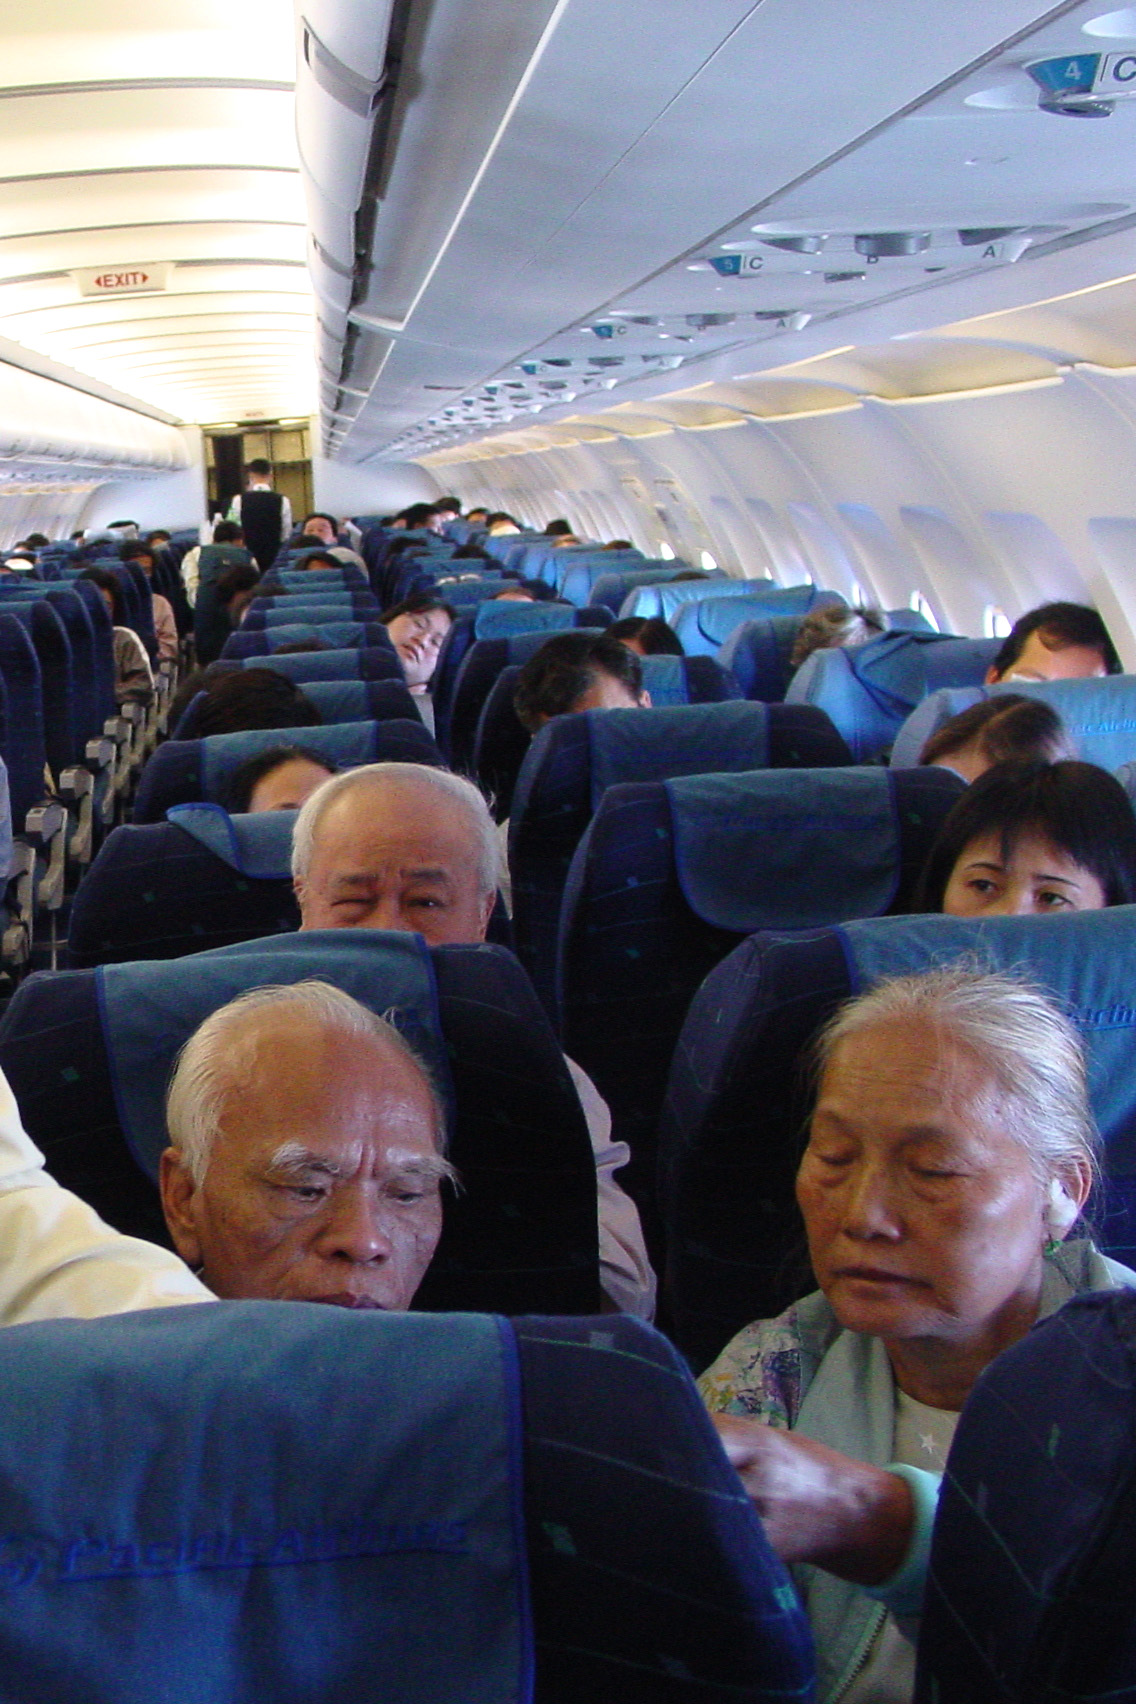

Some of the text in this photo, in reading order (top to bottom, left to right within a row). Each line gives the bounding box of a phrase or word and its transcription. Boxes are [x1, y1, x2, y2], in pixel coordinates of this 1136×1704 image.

[1065, 56, 1136, 82] 4 C
[749, 256, 763, 270] C
[103, 271, 140, 288] EXIT
